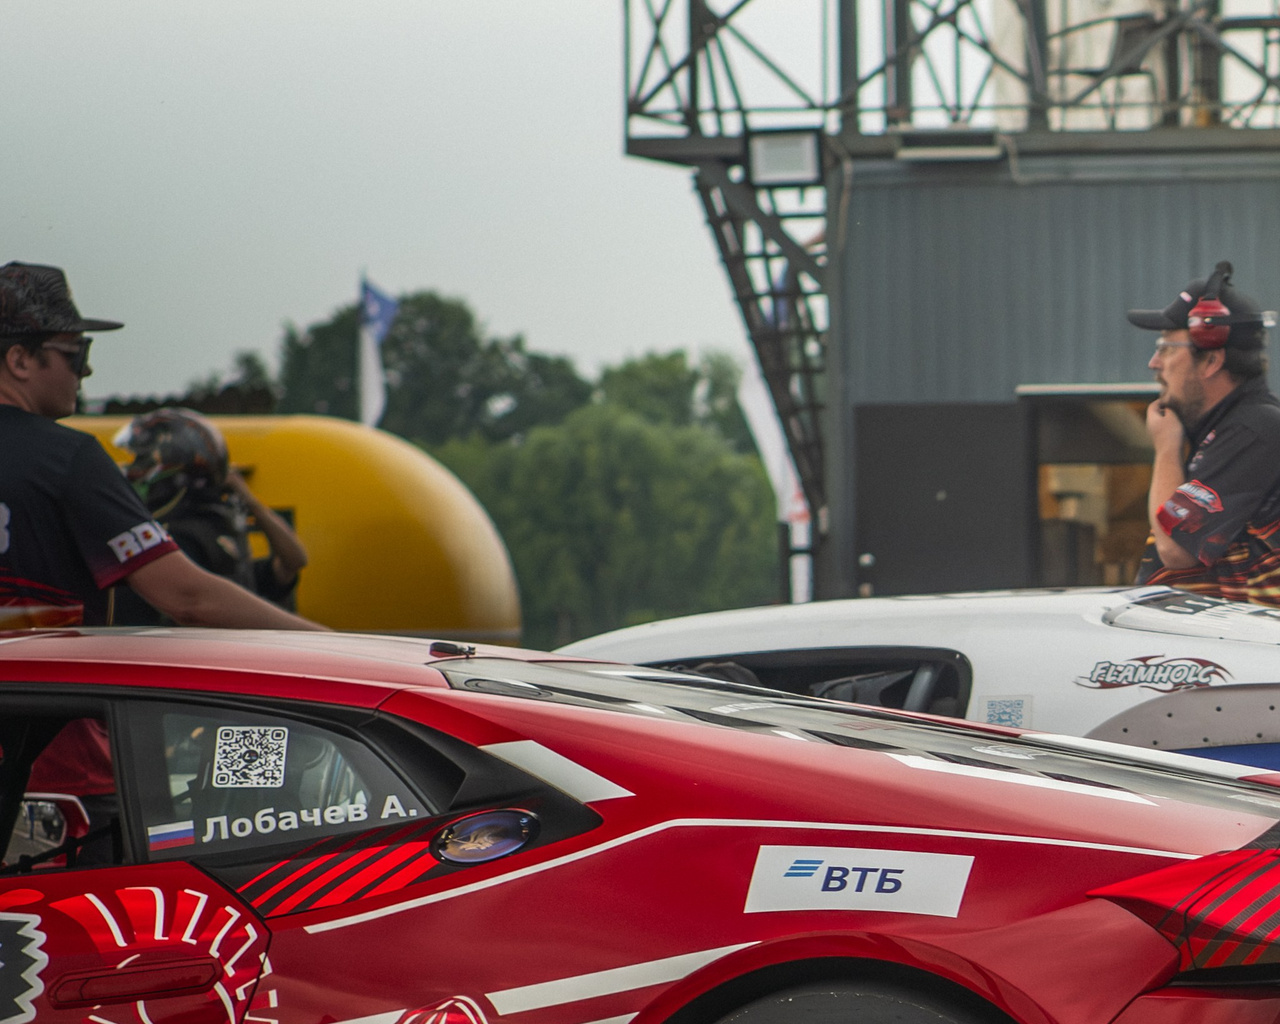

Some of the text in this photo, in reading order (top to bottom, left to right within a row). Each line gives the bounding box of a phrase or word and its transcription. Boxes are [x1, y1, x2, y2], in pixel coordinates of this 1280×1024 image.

[107, 521, 169, 563] RD
[1090, 661, 1215, 683] FLAMHOLC
[202, 794, 418, 843] Лобачев А.
[821, 866, 904, 893] ВТБ
